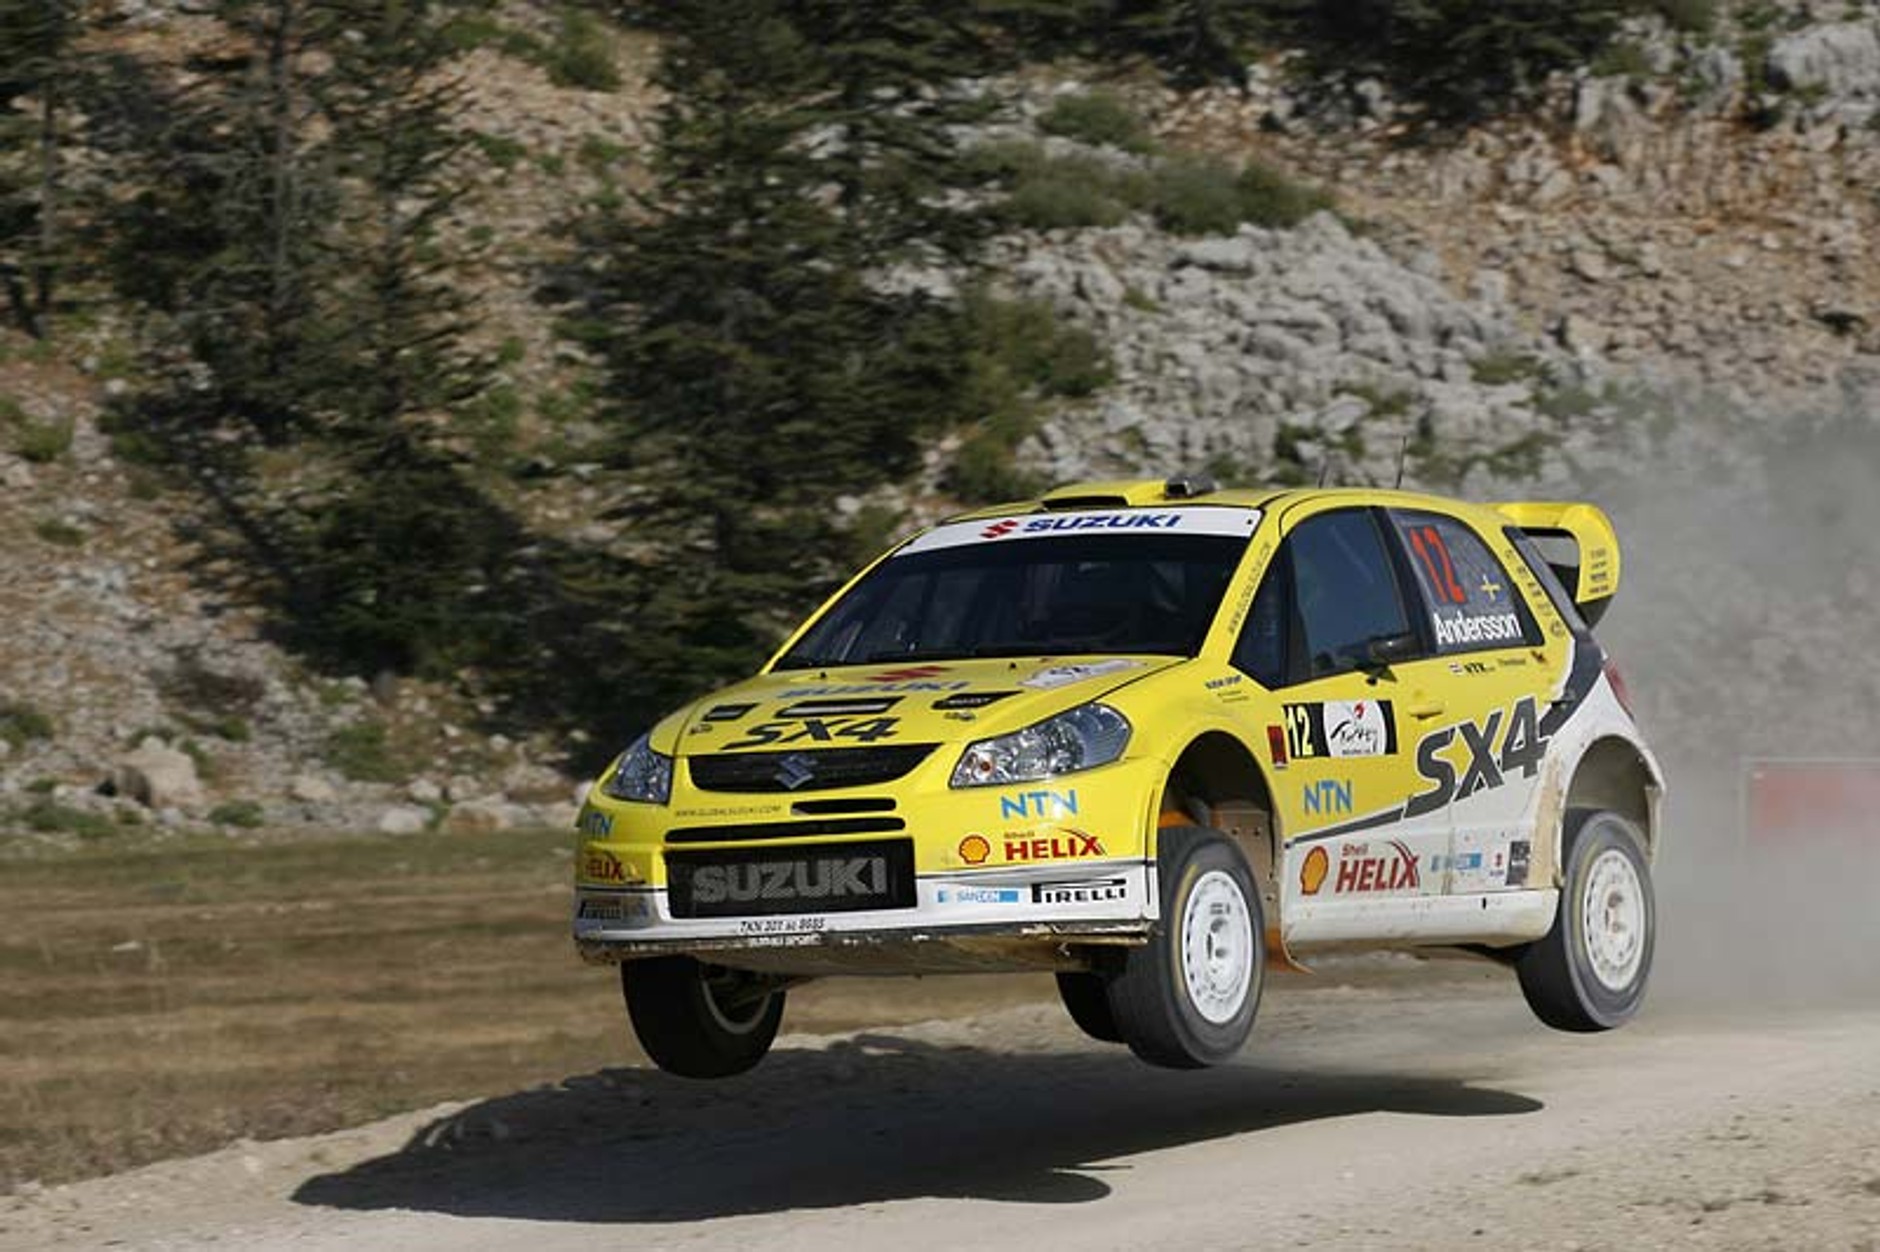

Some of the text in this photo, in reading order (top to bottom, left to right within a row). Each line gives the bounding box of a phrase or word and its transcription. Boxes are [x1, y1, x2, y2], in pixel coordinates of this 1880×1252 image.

[1022, 514, 1182, 533] SUZUKI
[1410, 526, 1467, 604] 12
[1433, 610, 1522, 645] Andersson
[721, 717, 901, 750] SX4
[1286, 705, 1314, 757] 12
[1404, 697, 1549, 819] SX4
[1001, 789, 1078, 819] NTN
[1304, 780, 1352, 815] NTN
[1004, 836, 1103, 861] HELIX
[692, 857, 887, 902] SUZUKI
[1031, 879, 1127, 904] PIRELLI
[1335, 856, 1420, 894] HELIX
